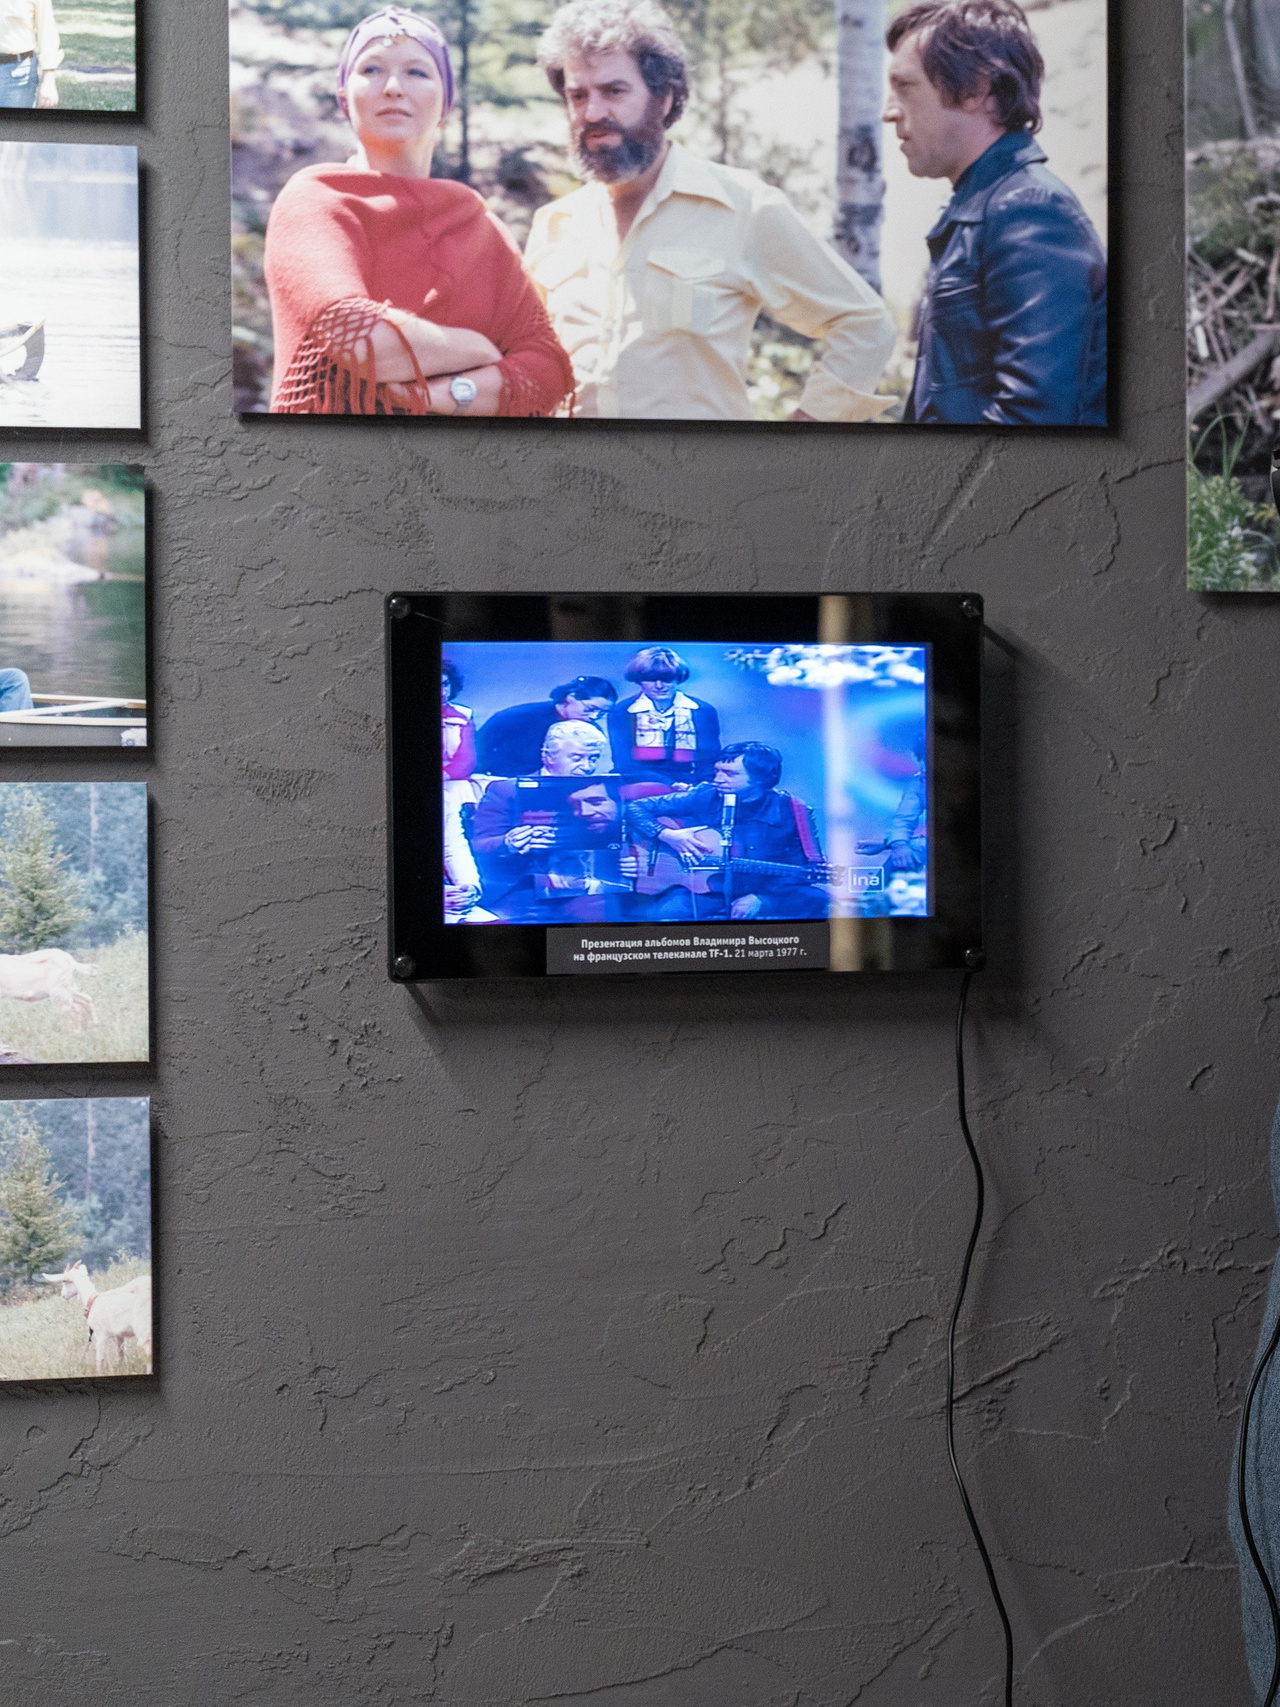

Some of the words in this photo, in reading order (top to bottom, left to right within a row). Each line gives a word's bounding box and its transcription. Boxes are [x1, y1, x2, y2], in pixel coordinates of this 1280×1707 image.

[852, 874, 880, 886] ina
[581, 938, 643, 950] Презентация
[644, 937, 691, 948] альбомов
[693, 936, 746, 948] Владимира
[748, 935, 800, 947] Высоцкого
[573, 952, 585, 961] на
[586, 950, 650, 963] французском
[652, 950, 708, 960] телеканале
[709, 949, 733, 958] TF-1.
[734, 948, 745, 958] 21
[747, 949, 774, 959] марта
[776, 947, 797, 957] 1977
